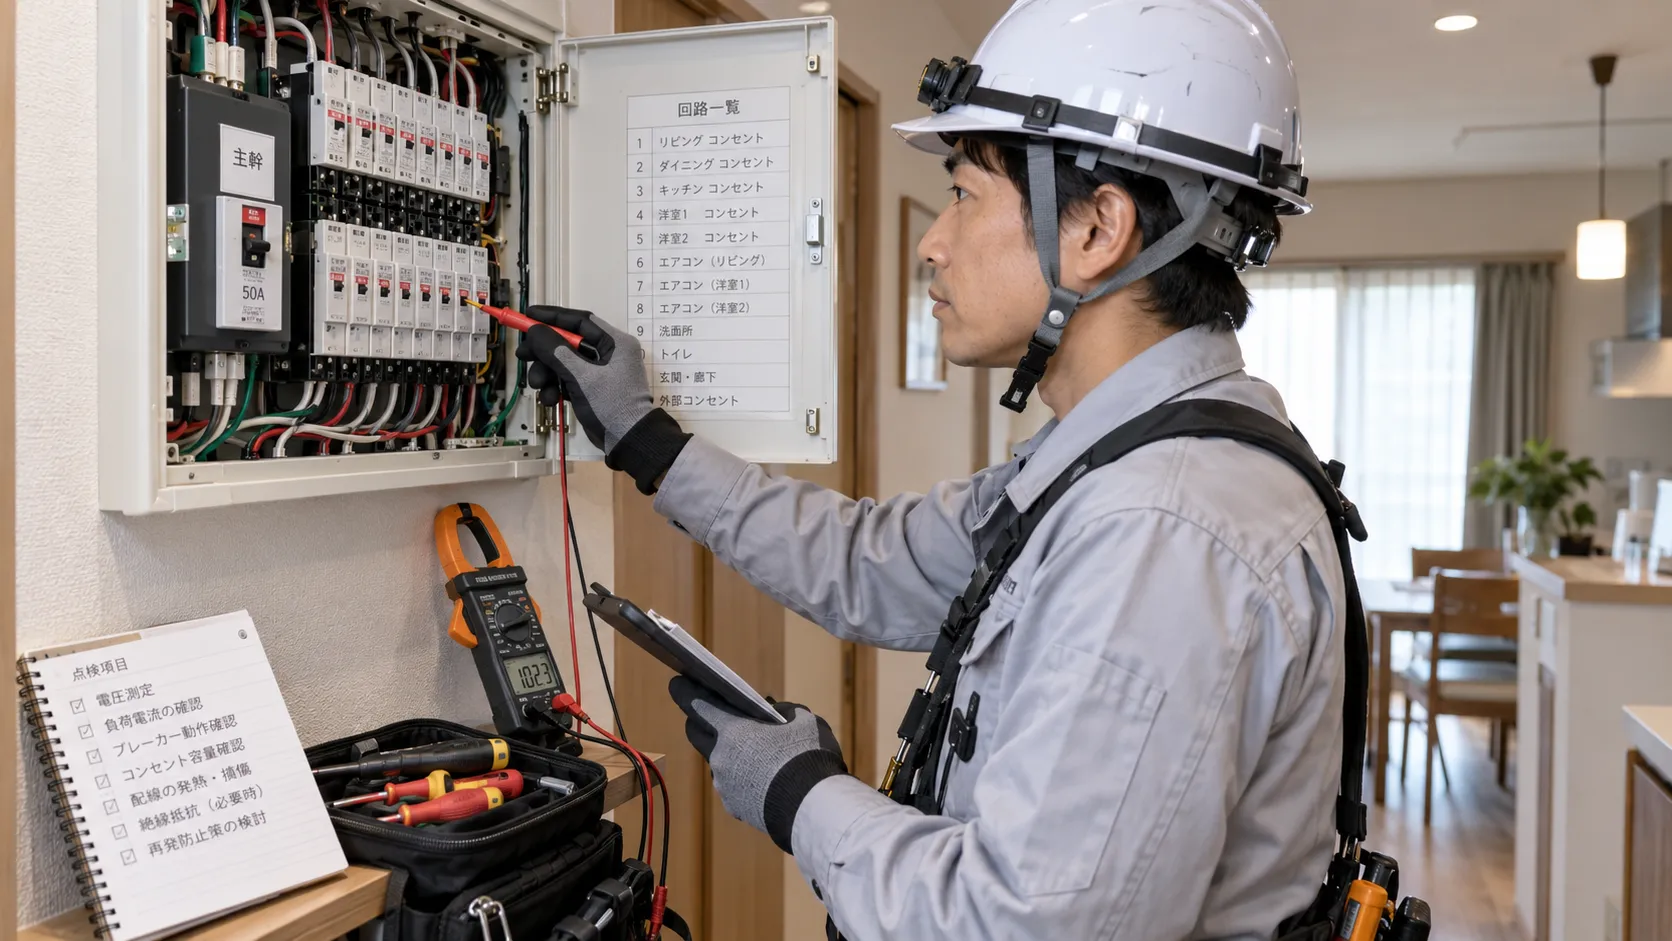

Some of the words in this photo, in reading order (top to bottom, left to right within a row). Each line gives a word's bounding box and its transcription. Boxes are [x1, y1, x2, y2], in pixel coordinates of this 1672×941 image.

[678, 100, 740, 117] 回路一覧
[637, 139, 642, 148] 1
[660, 134, 704, 147] リビング
[708, 133, 764, 145] コンセント
[233, 147, 263, 170] 主幹
[636, 162, 643, 172] 2
[659, 158, 714, 171] ダイニング
[719, 156, 774, 169] コンセント
[636, 186, 643, 196] 3
[659, 184, 703, 195] キッチン
[708, 182, 764, 193] コンセント
[636, 210, 643, 220] 4
[658, 208, 687, 221] 洋室1
[704, 207, 759, 218] コンセント
[636, 234, 643, 244] 5
[658, 232, 688, 245] 洋室2
[704, 231, 759, 242] コンセント
[636, 258, 643, 268] 6
[242, 286, 265, 300] 50A
[637, 281, 643, 291] 7
[637, 304, 643, 314] 8
[637, 326, 643, 336] 9
[659, 325, 693, 336] 洗面所
[661, 349, 692, 359] トイレ
[659, 371, 716, 384] 玄関・廊下
[659, 394, 739, 407] 外部コンセント
[72, 657, 129, 682] 点検項目
[96, 683, 155, 708] 電圧測定
[104, 696, 203, 734] 負荷電流の確認
[113, 715, 238, 757] ブレーカー動作確認
[122, 738, 246, 782] コンセント容量確認
[147, 810, 267, 857] 再発防止策の検討
